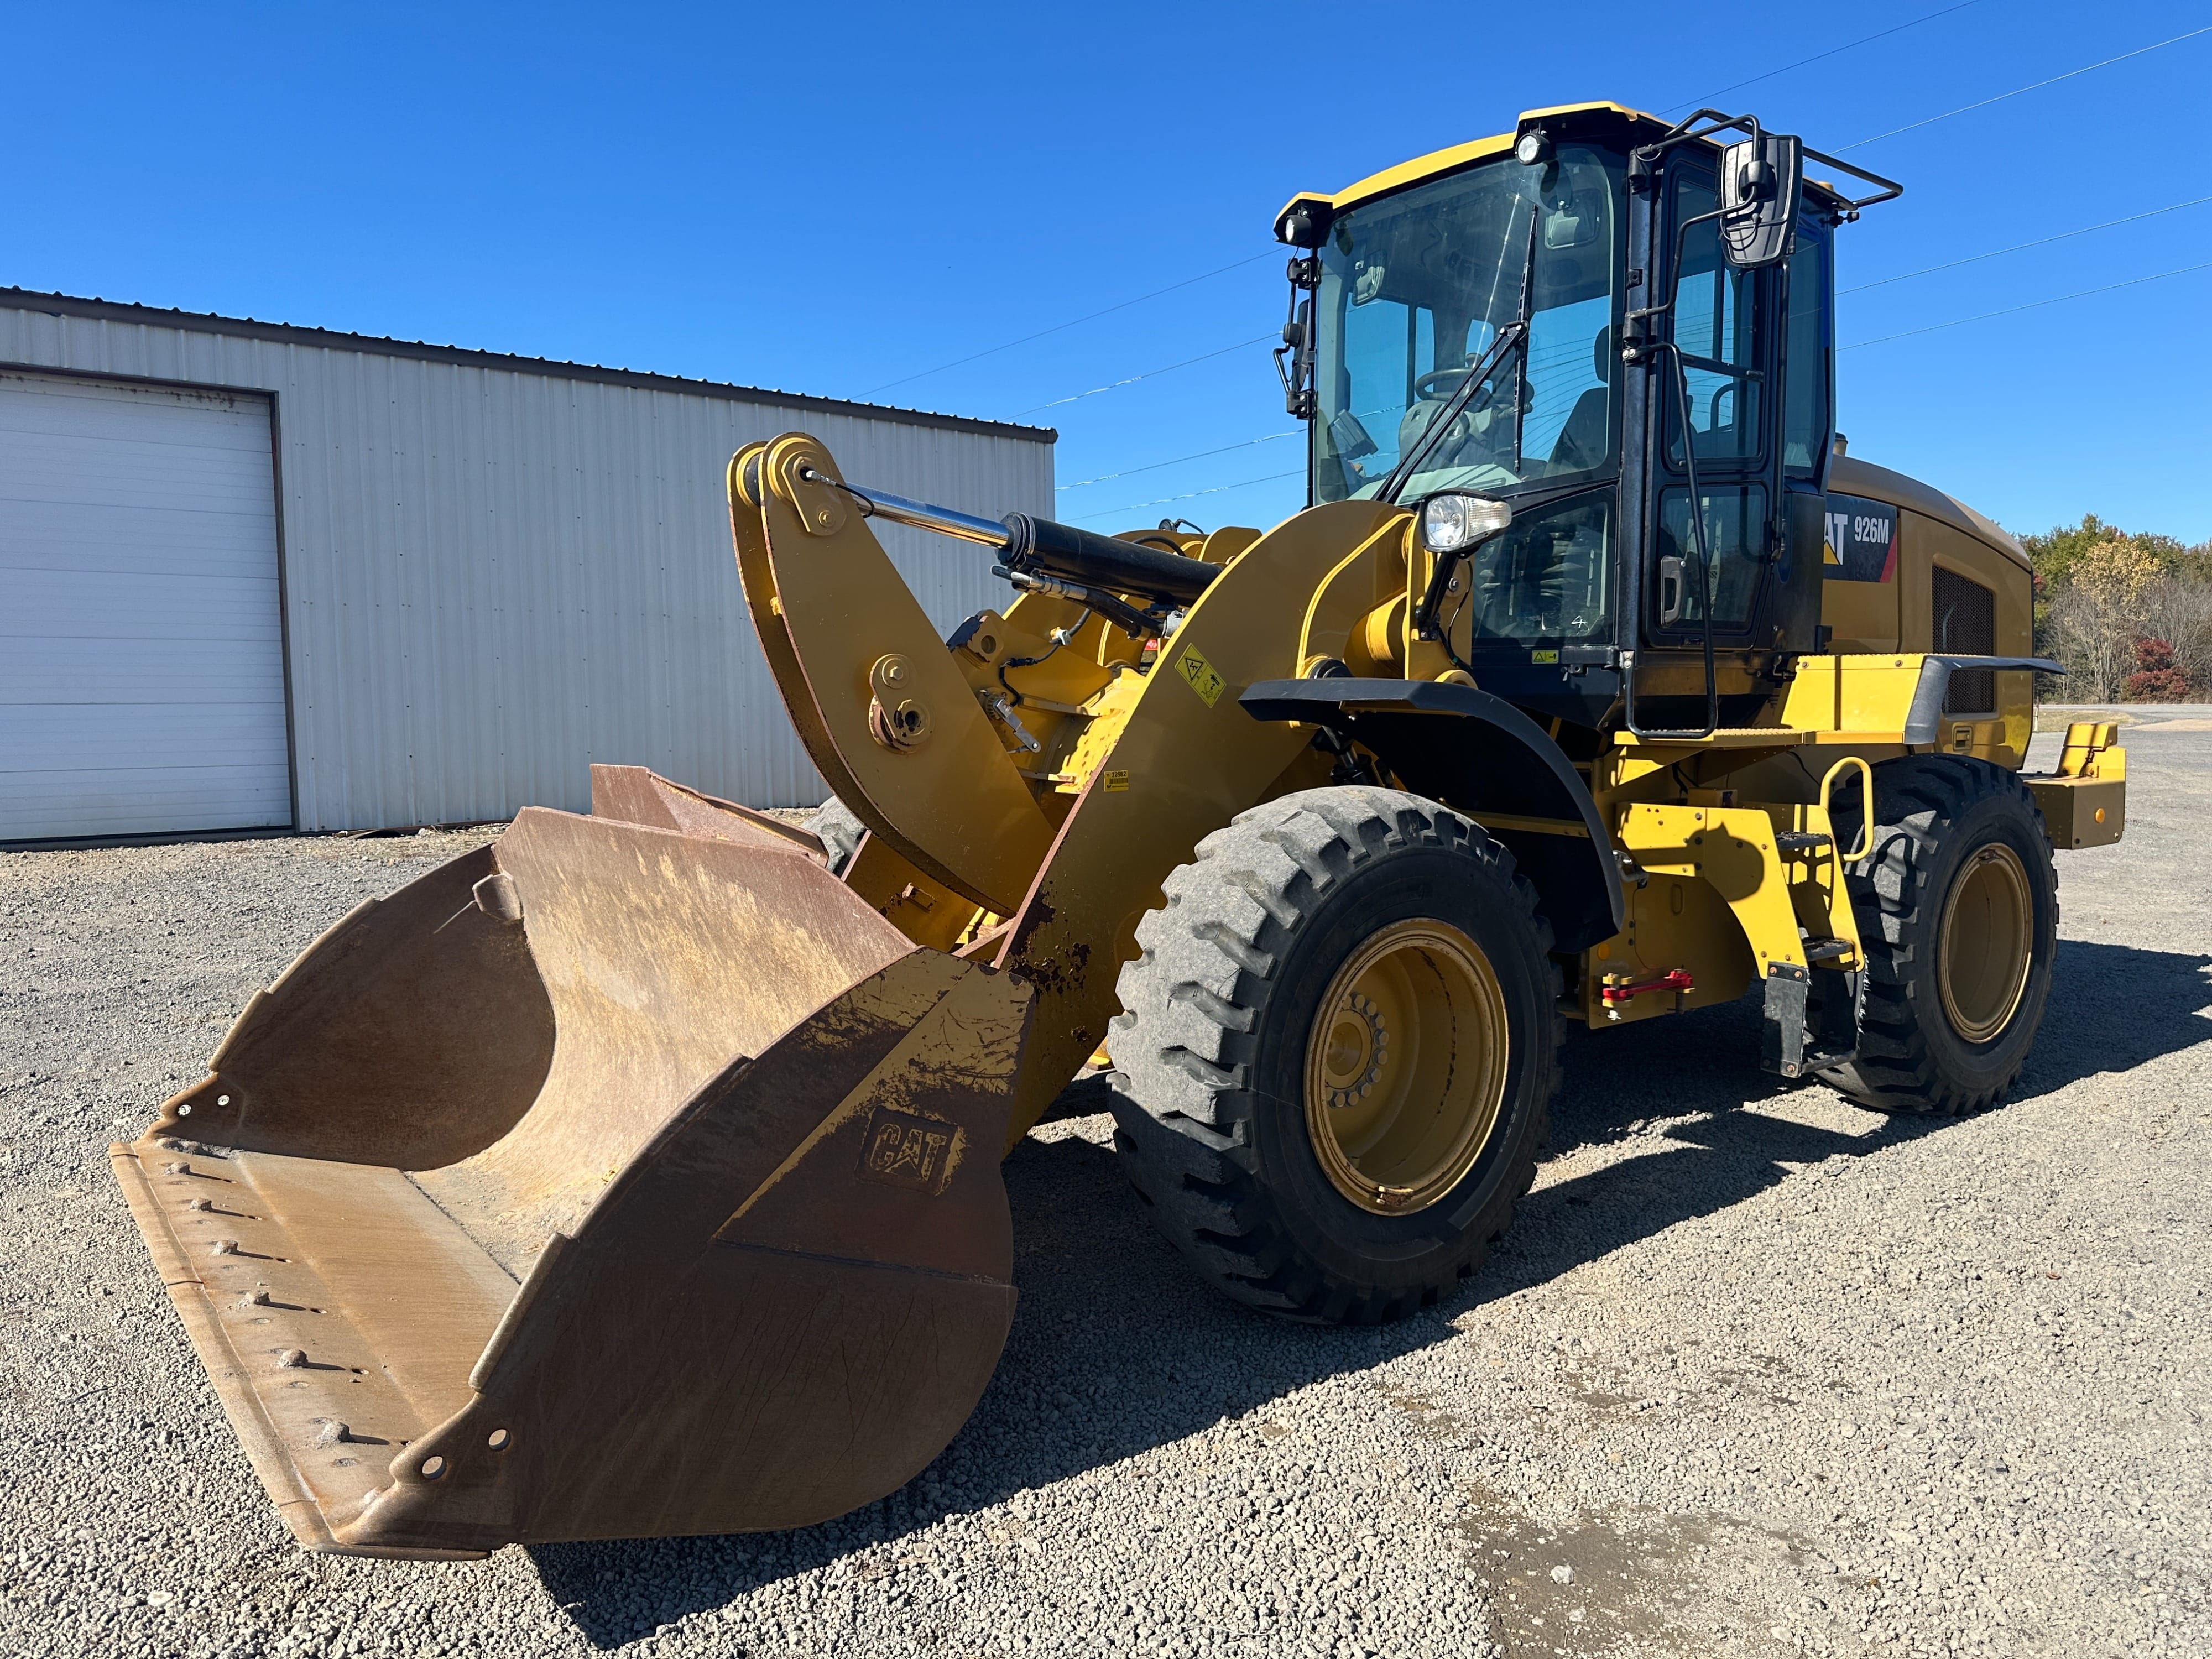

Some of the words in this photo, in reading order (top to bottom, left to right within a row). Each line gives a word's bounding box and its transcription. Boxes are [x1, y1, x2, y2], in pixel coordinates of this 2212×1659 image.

[1824, 512, 1848, 565] AT
[1854, 515, 1889, 544] 926M
[870, 1124, 947, 1181] CAT
